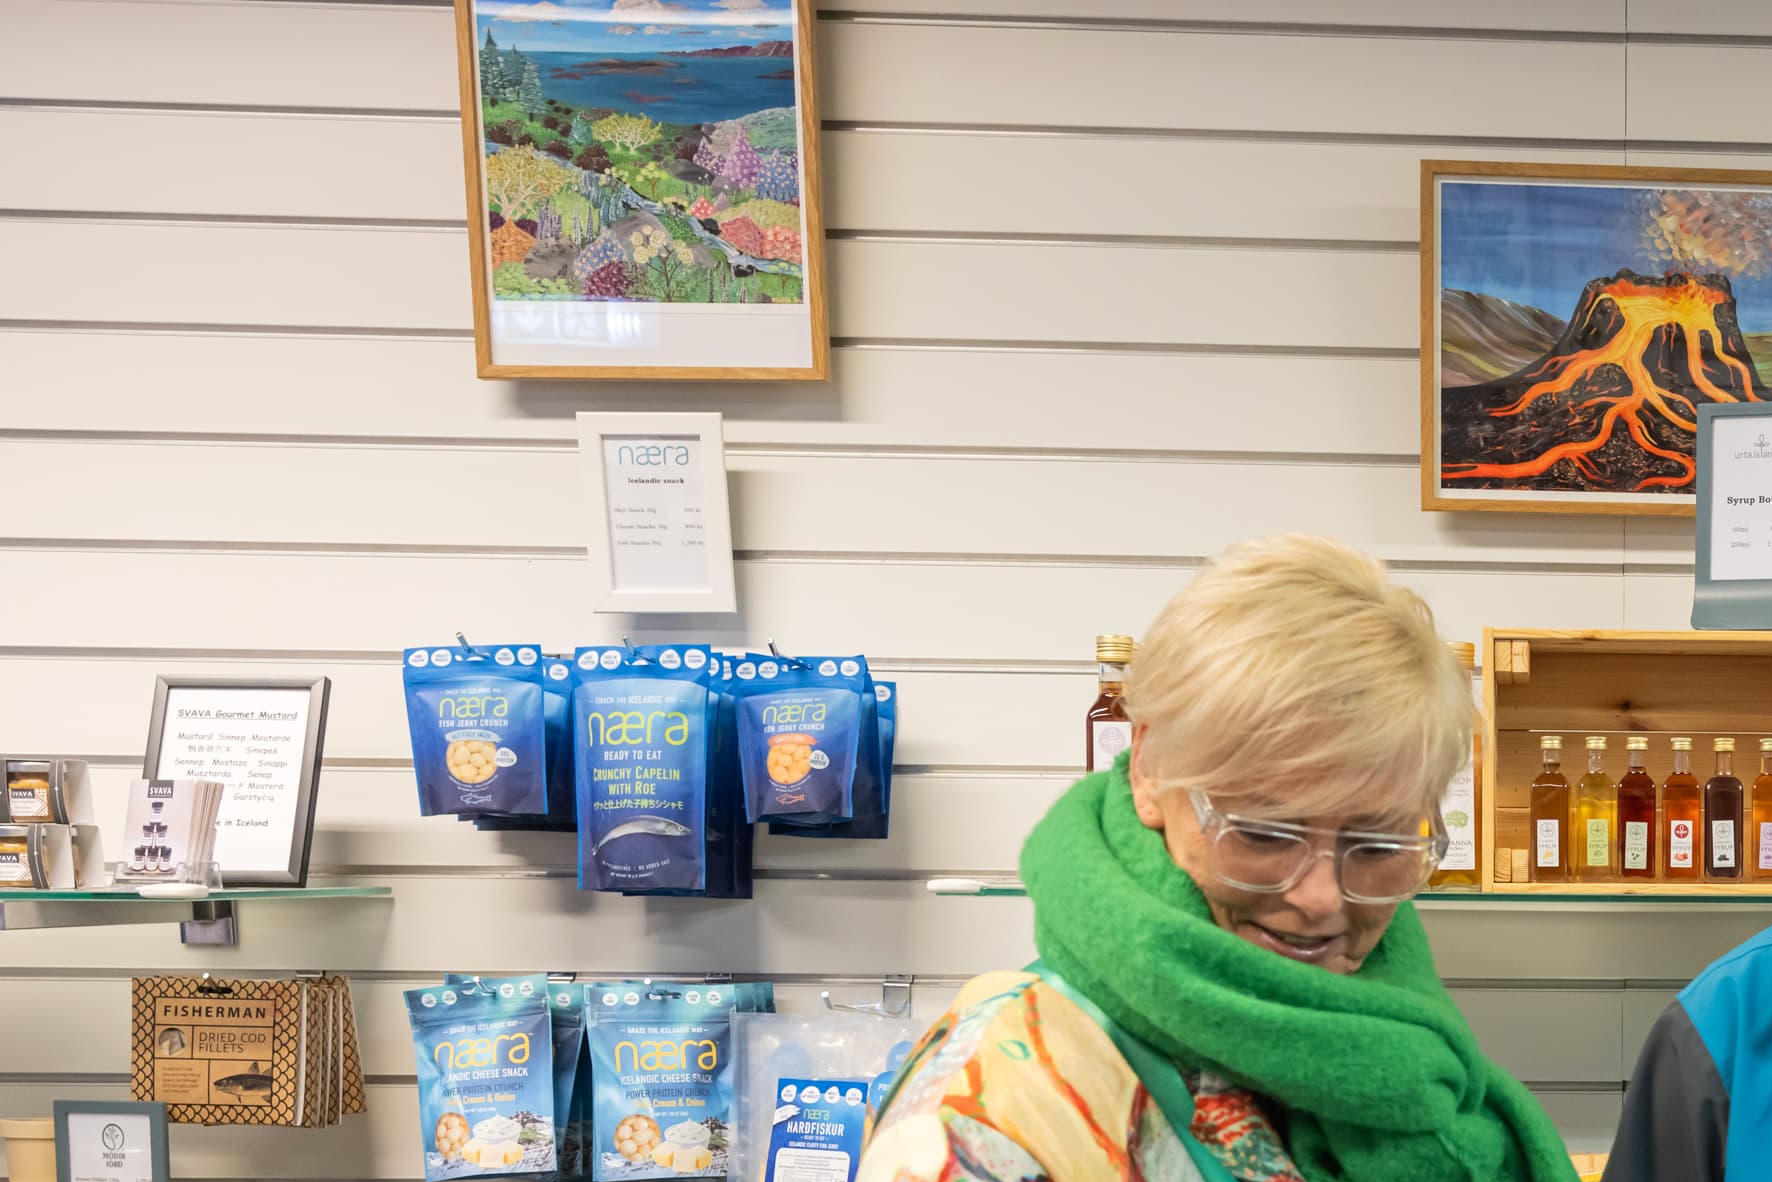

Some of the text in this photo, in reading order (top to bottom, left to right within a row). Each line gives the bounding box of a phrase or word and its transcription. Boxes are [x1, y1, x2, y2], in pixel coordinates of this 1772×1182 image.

[618, 445, 689, 466] næra
[1727, 496, 1756, 506] Syrup
[439, 696, 509, 718] næra
[178, 709, 298, 720] SVAVA Gourmet Mustard
[762, 703, 827, 725] næra
[439, 719, 508, 728] FISH JERKY CRUNCH
[588, 711, 689, 747] næra
[177, 732, 291, 742] Mustard Sinnep Moutarde
[604, 750, 662, 761] READY TO EAT
[174, 758, 204, 766] Sennep
[150, 786, 172, 795] SVAVA
[236, 819, 269, 827] Iceland
[163, 1005, 266, 1019] FISHERMAN
[199, 1032, 266, 1043] DRIED COD
[199, 1043, 244, 1054] FILLETS
[434, 1032, 530, 1069] næra
[614, 1039, 717, 1073] næra
[473, 1069, 500, 1080] CHEESE
[502, 1067, 528, 1077] SNACK
[661, 1073, 690, 1084] CHEESE
[462, 1084, 492, 1095] PROTEIN
[494, 1082, 524, 1092] CRUNCH
[652, 1088, 683, 1098] PROTEIN
[804, 1109, 830, 1120] næra
